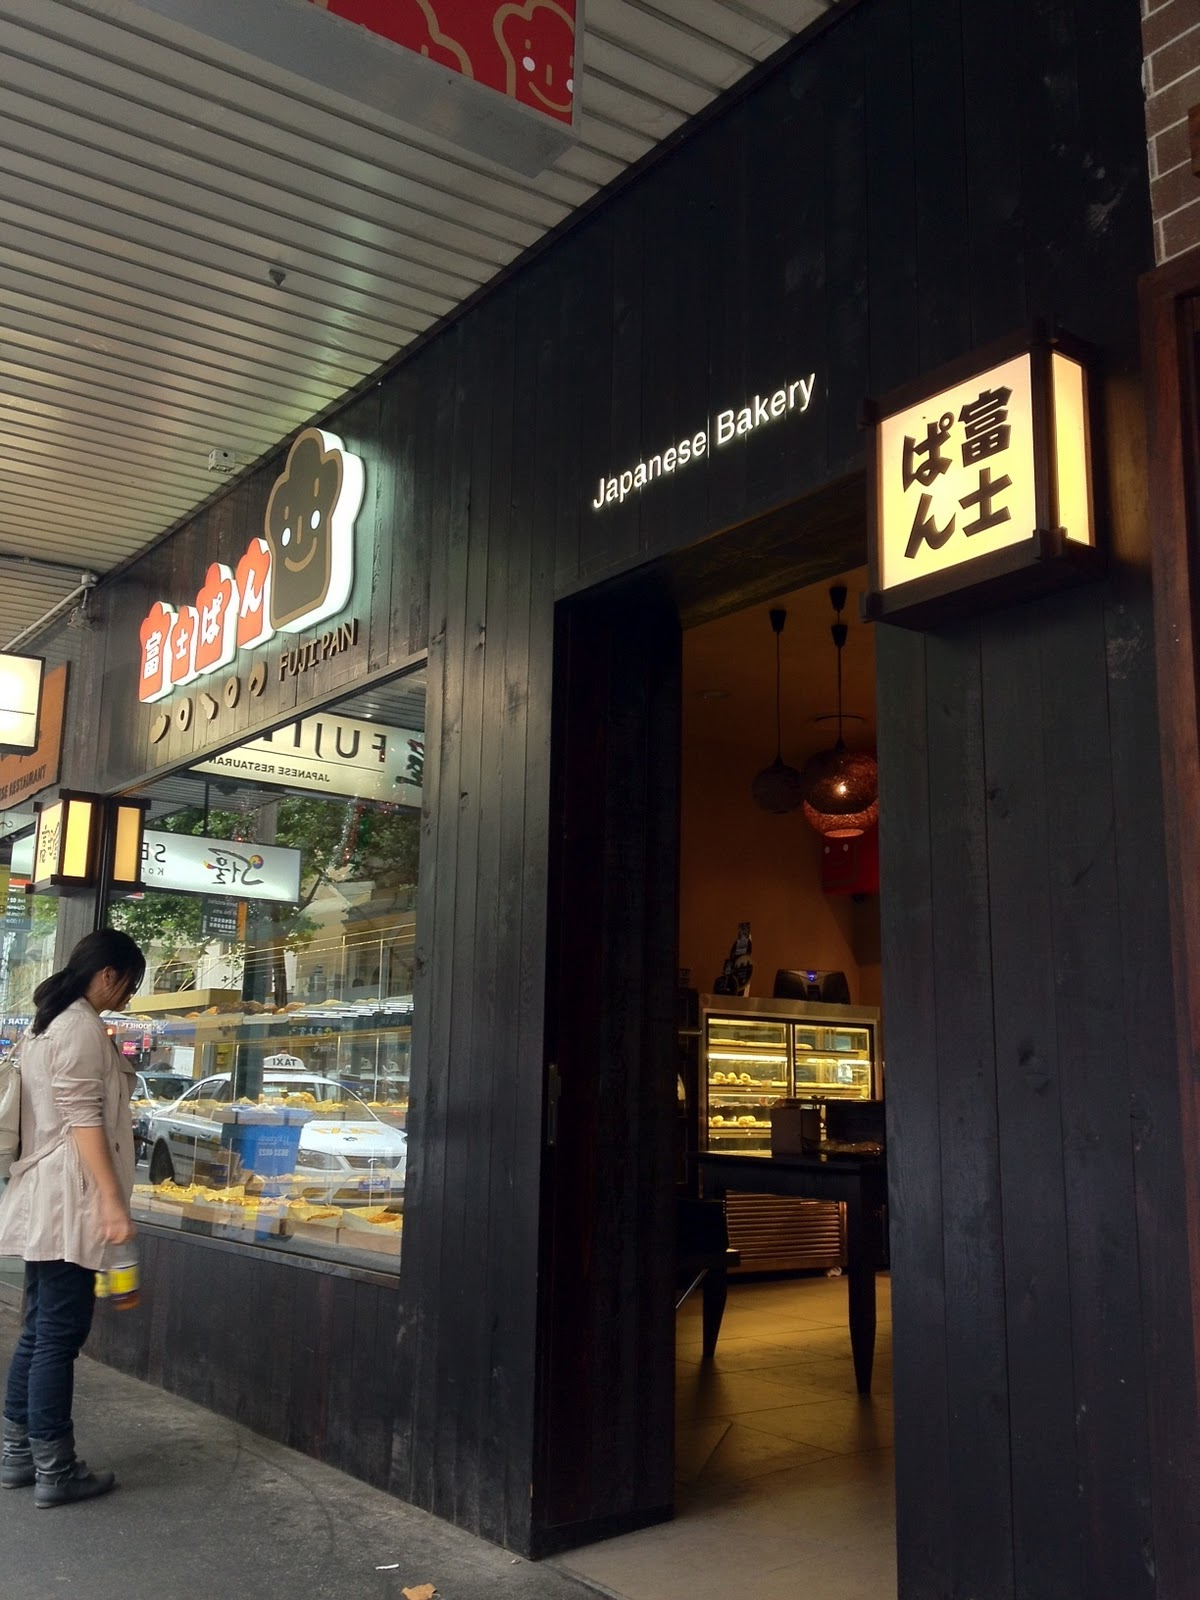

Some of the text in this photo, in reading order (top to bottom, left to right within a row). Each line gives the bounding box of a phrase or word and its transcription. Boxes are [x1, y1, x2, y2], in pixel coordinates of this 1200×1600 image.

[594, 373, 816, 509] Japanese Bakery
[901, 385, 1013, 559] 富士 ぱん
[143, 568, 264, 680] 富士ぱん
[9, 764, 47, 796] RESTAURANT
